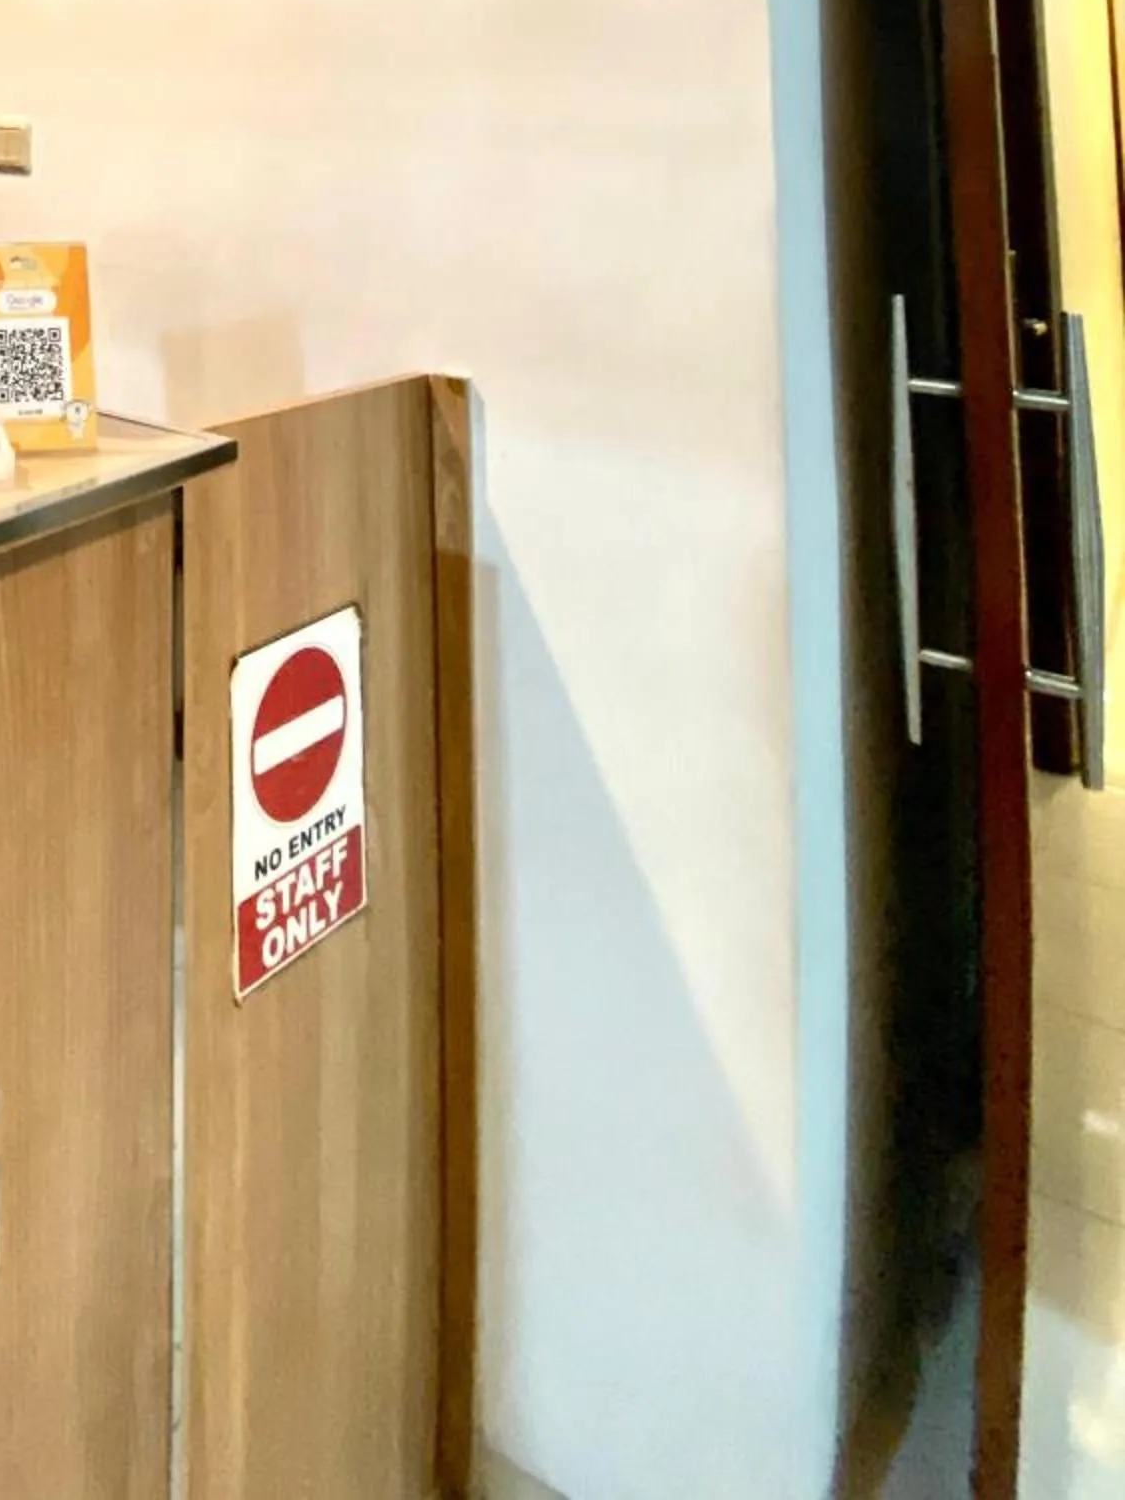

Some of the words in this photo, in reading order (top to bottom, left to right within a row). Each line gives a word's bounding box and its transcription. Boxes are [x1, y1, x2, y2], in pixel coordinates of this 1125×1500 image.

[254, 847, 282, 882] NO
[288, 803, 347, 861] ENTRY
[255, 836, 349, 931] STAFF
[261, 881, 344, 970] ONLY
